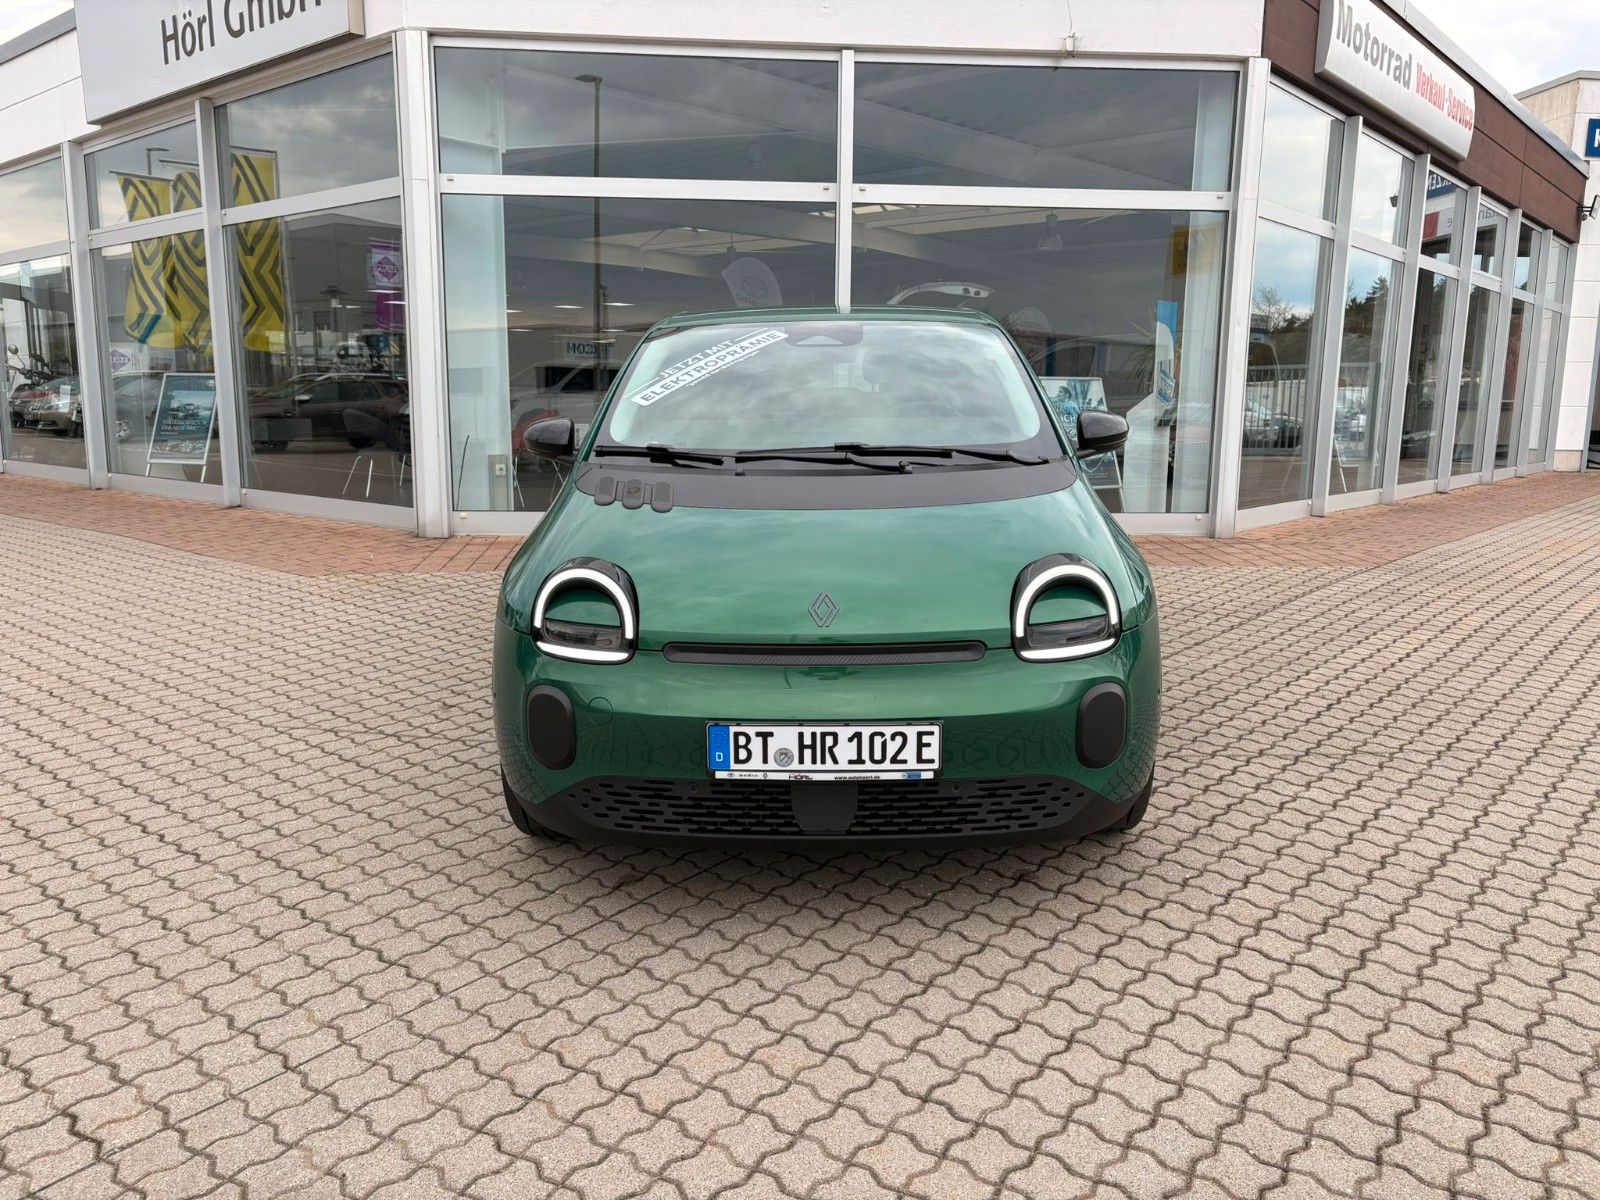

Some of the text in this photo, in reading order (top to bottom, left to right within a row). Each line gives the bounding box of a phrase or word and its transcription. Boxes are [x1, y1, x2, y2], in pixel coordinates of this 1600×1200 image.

[161, 0, 215, 65] Hörl
[1336, 0, 1412, 90] Motorrad
[640, 332, 781, 402] ELEKTROPRÄMIE
[660, 353, 704, 378] JETZT
[704, 340, 735, 355] MIT
[715, 752, 724, 762] D
[733, 731, 774, 764] BT
[798, 731, 839, 765] HR
